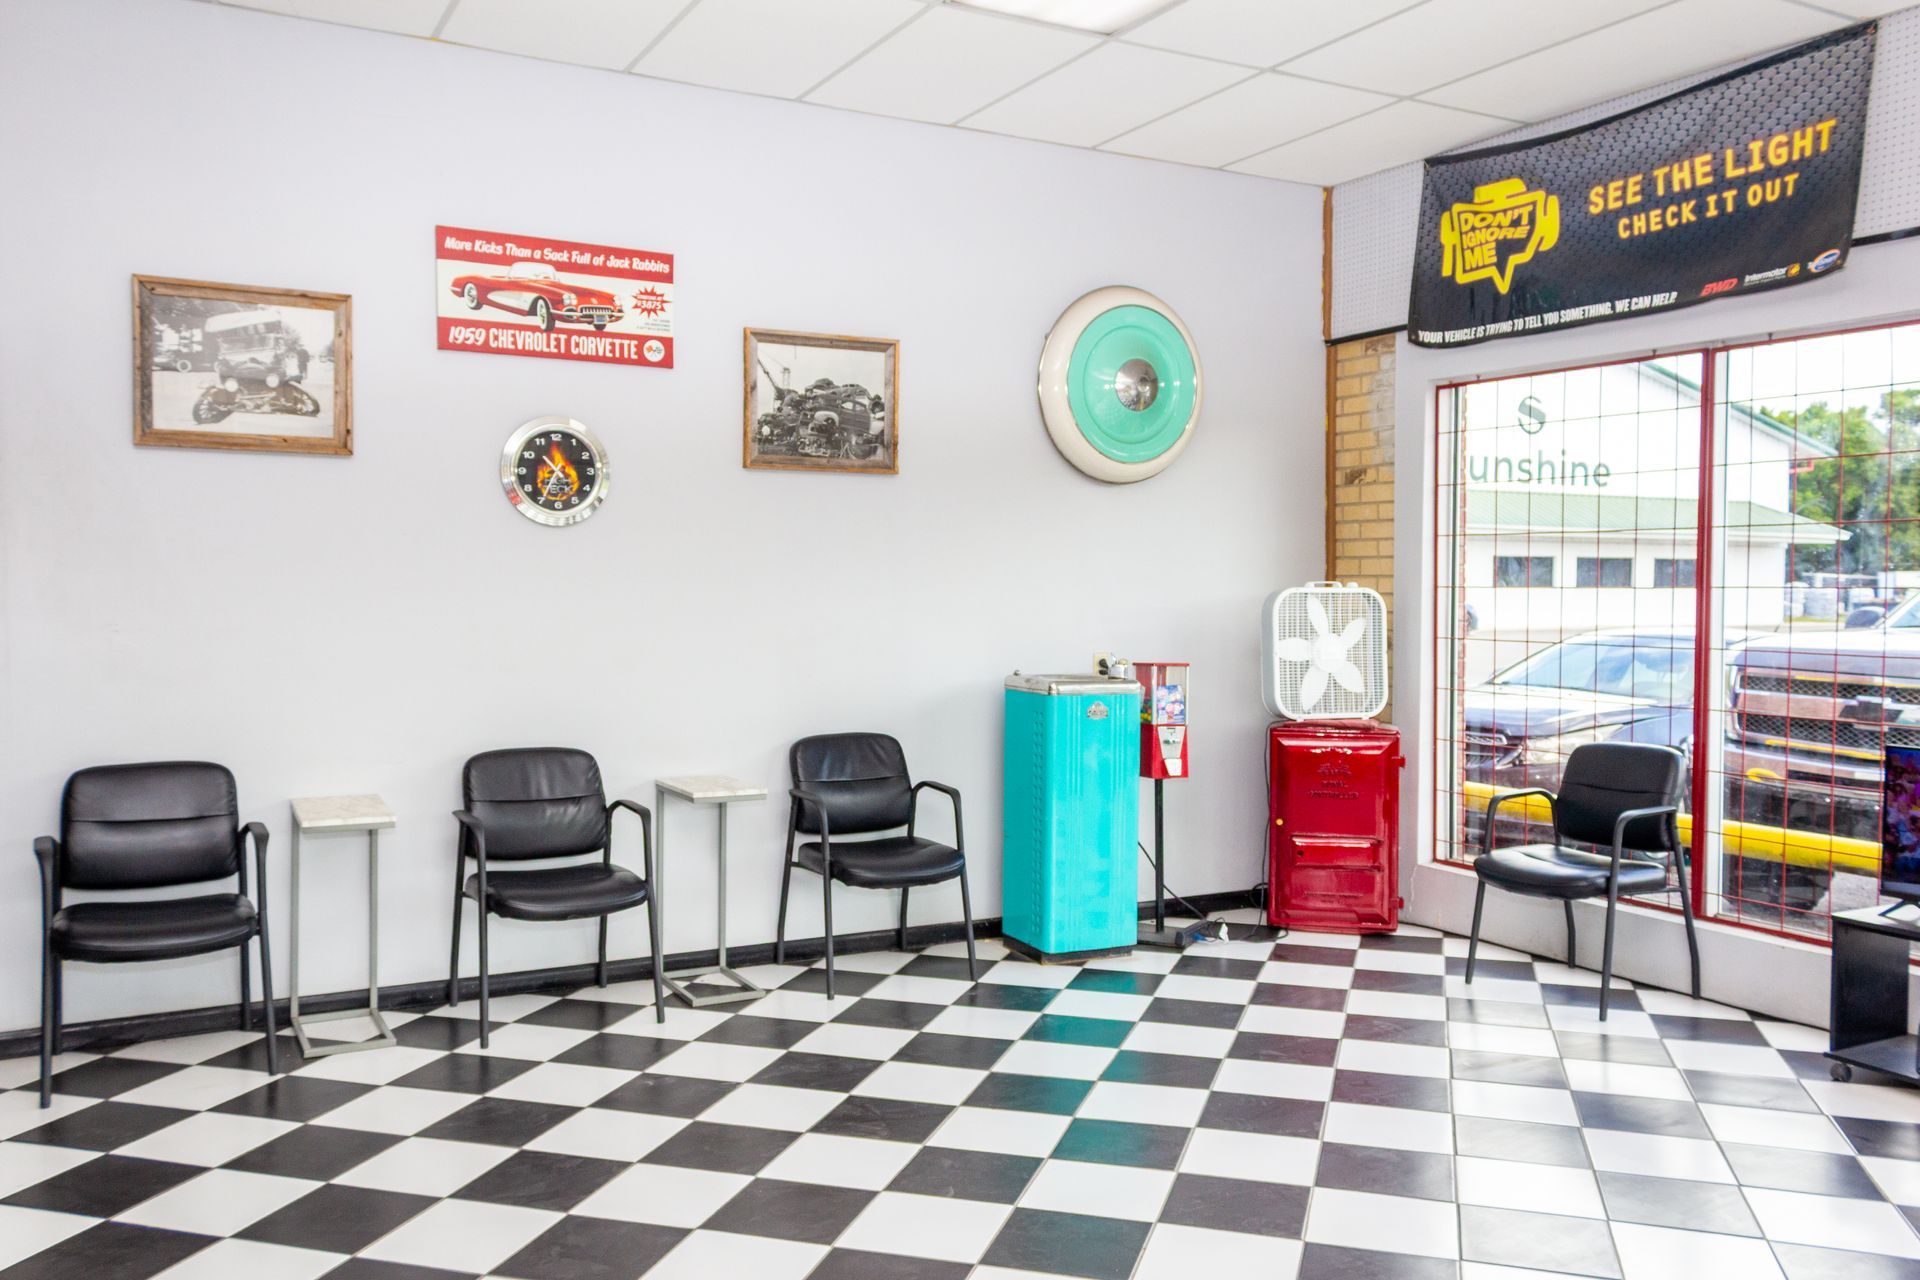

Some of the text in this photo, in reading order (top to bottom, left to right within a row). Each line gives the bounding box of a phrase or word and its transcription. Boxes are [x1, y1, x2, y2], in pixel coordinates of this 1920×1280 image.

[1588, 117, 1837, 215] SEE THE LIGHT
[1459, 204, 1533, 231] DON'T
[1617, 172, 1800, 240] CHECK IT OUT
[1461, 225, 1530, 248] IGNORE
[444, 236, 670, 273] More Kicks Than a Sack Full of Jack Rabbits
[1463, 242, 1497, 271] ME
[1700, 278, 1739, 298] BWD
[1418, 291, 1678, 343] YOUR VEHICLE IS TRYING TO TELL YOU SOMETHING. WE CAN HELP
[449, 326, 638, 359] 1959 CHEVROLET CORVETTE
[1518, 396, 1546, 435] S
[522, 451, 535, 459] 10
[534, 438, 546, 446] 11
[518, 467, 527, 475] 9
[587, 467, 595, 475] 3
[1469, 448, 1611, 487] unshine
[524, 484, 532, 492] 8
[554, 501, 563, 509] 6
